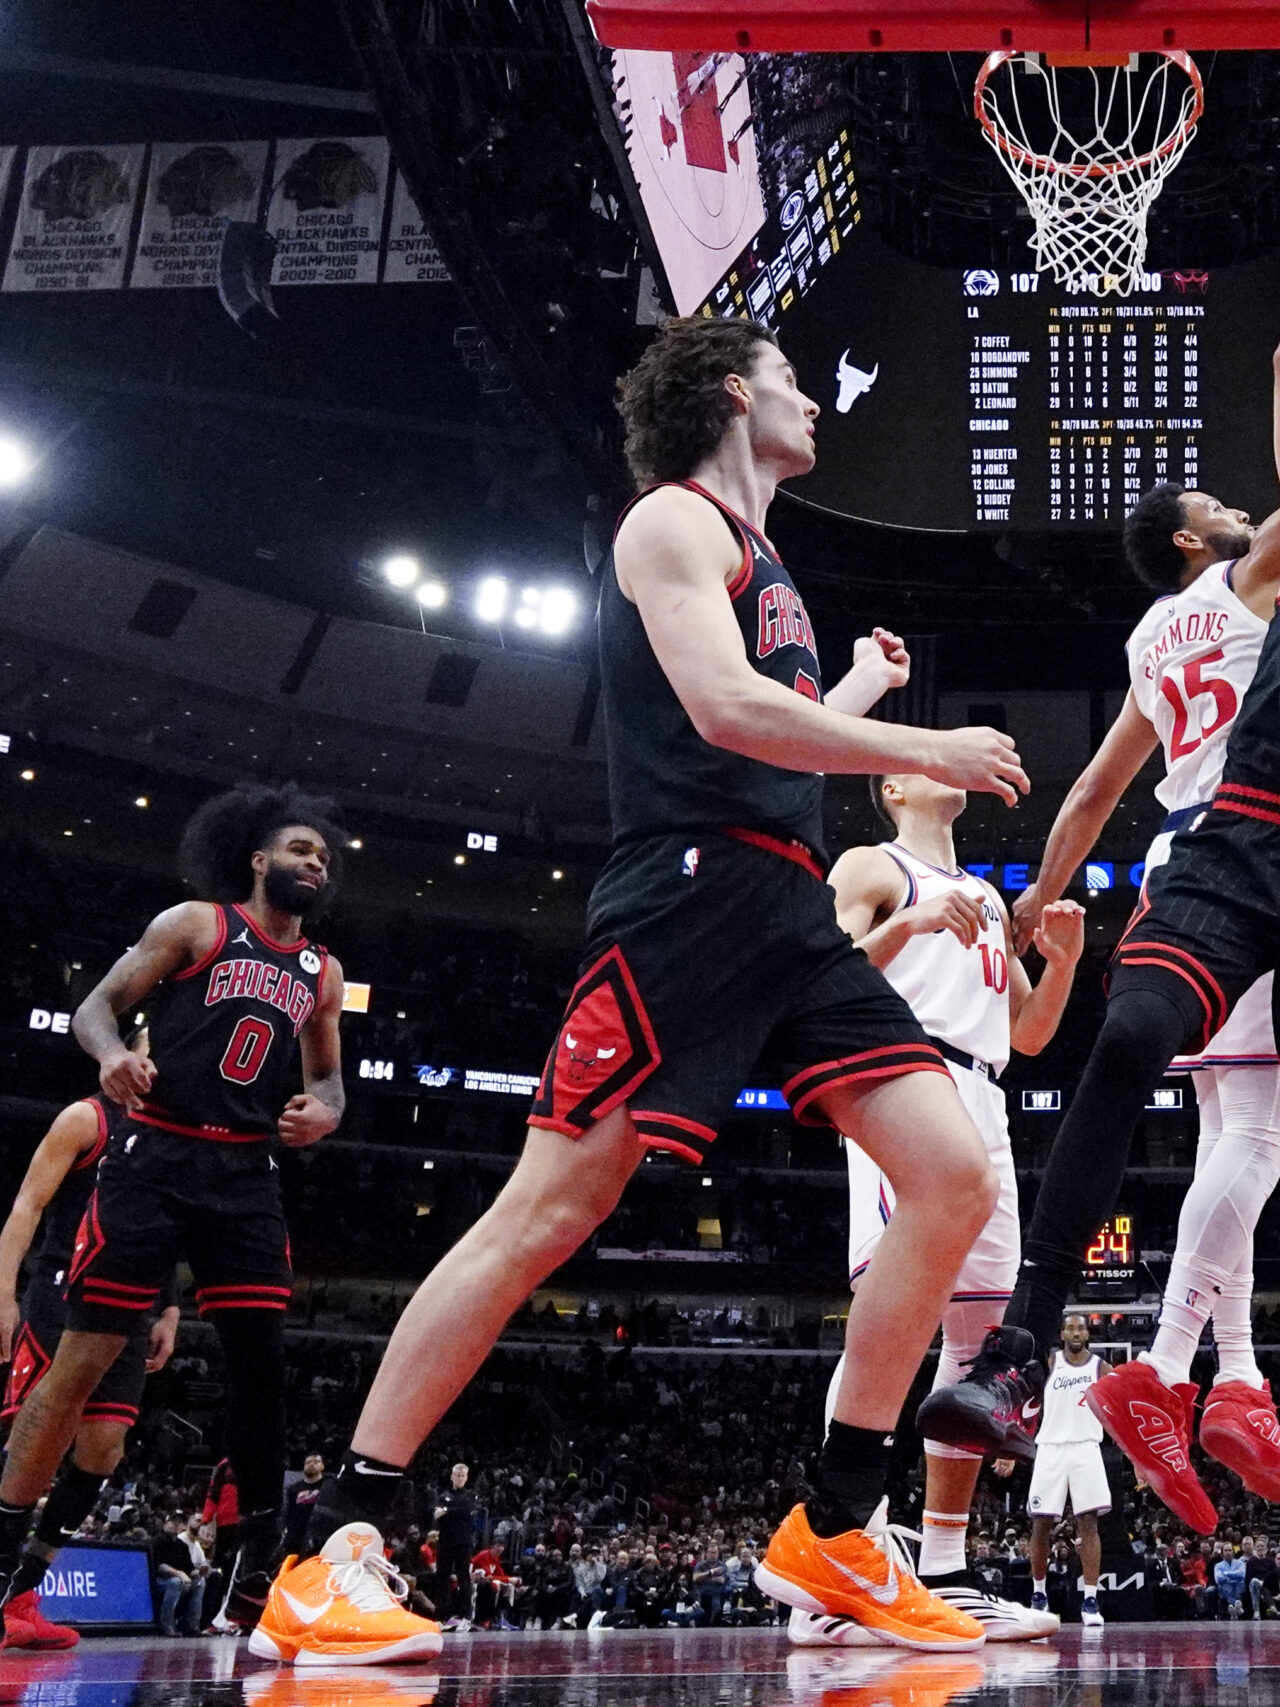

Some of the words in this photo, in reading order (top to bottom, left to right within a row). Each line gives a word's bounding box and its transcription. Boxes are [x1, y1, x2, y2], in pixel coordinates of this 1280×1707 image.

[297, 214, 353, 226] CHICAGO
[43, 221, 101, 233] CHICAGO
[276, 227, 369, 240] BLACKHAWKS
[22, 234, 116, 247] BLACKHAWKS
[278, 242, 321, 253] NTRAL
[326, 241, 379, 252] DIVISION
[280, 255, 358, 268] CHAMPIONS
[24, 262, 101, 275] CHAMPIONS
[279, 269, 356, 281] 2009-2010
[1010, 274, 1039, 292] 107
[967, 307, 979, 318] LA
[1082, 324, 1094, 332] PTS
[1187, 324, 1194, 332] FT
[974, 336, 979, 348] 7
[982, 336, 1010, 348] COFFEY
[971, 352, 979, 363] 10
[982, 352, 1030, 363] BOGDANOVIC
[970, 367, 979, 378] 25
[982, 367, 1018, 378] SIMMONS
[970, 382, 979, 393] 33
[982, 382, 1008, 393] BATUM
[975, 398, 980, 408] 2
[983, 398, 1016, 408] LEONARD
[970, 420, 1009, 431] CHICAGO
[972, 449, 981, 460] 13
[984, 449, 1017, 460] HUERTER
[971, 464, 981, 475] 30
[984, 464, 1008, 475] JONES
[973, 479, 981, 490] 12
[984, 479, 1015, 490] COLLINS
[977, 494, 981, 505] 3
[984, 494, 1011, 505] GIDDEY
[977, 509, 982, 520] 0
[985, 509, 1009, 520] WHITE
[1144, 614, 1229, 680] SIMMONS
[1161, 649, 1238, 763] 25
[466, 832, 498, 852] DE
[978, 943, 1008, 995] 10
[205, 959, 314, 1038] CHICAGO
[30, 1008, 69, 1034] DE
[219, 1015, 274, 1085] 0
[466, 1070, 506, 1084] VANCOUVER
[464, 1080, 478, 1090] LOS
[478, 1081, 510, 1094] ANGELES
[1032, 1092, 1052, 1108] 107
[1116, 1218, 1130, 1234] 10
[1088, 1235, 1126, 1264] 24
[1096, 1270, 1134, 1278] TISSOT
[1053, 1374, 1092, 1391] Clippers
[1078, 1390, 1087, 1408] 2
[1129, 1401, 1187, 1473] AIR
